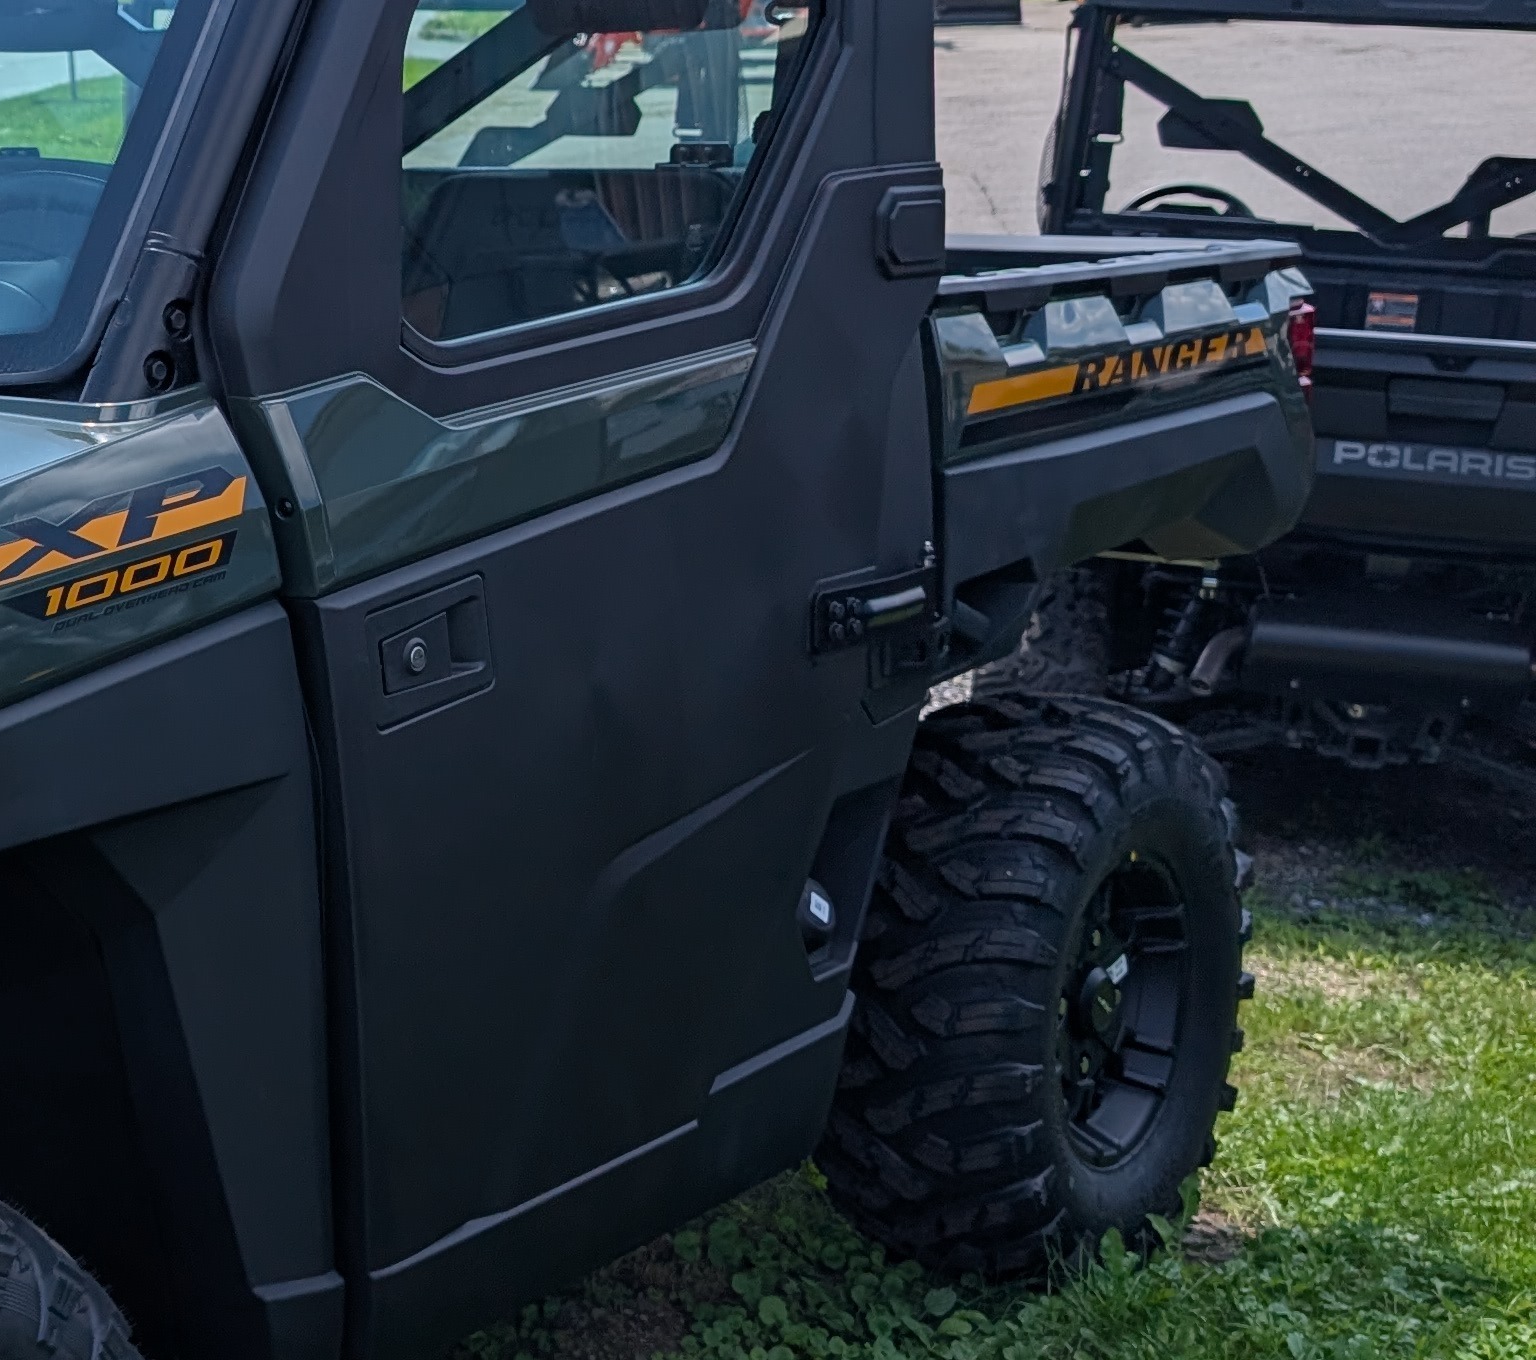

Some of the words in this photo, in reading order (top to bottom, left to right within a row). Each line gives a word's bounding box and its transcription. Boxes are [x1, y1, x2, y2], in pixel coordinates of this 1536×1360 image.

[1073, 326, 1252, 392] RANGER
[1332, 440, 1536, 480] POLARIS
[44, 538, 223, 617] 1000
[53, 611, 99, 632] DUAL
[103, 582, 190, 615] OVERHEAD
